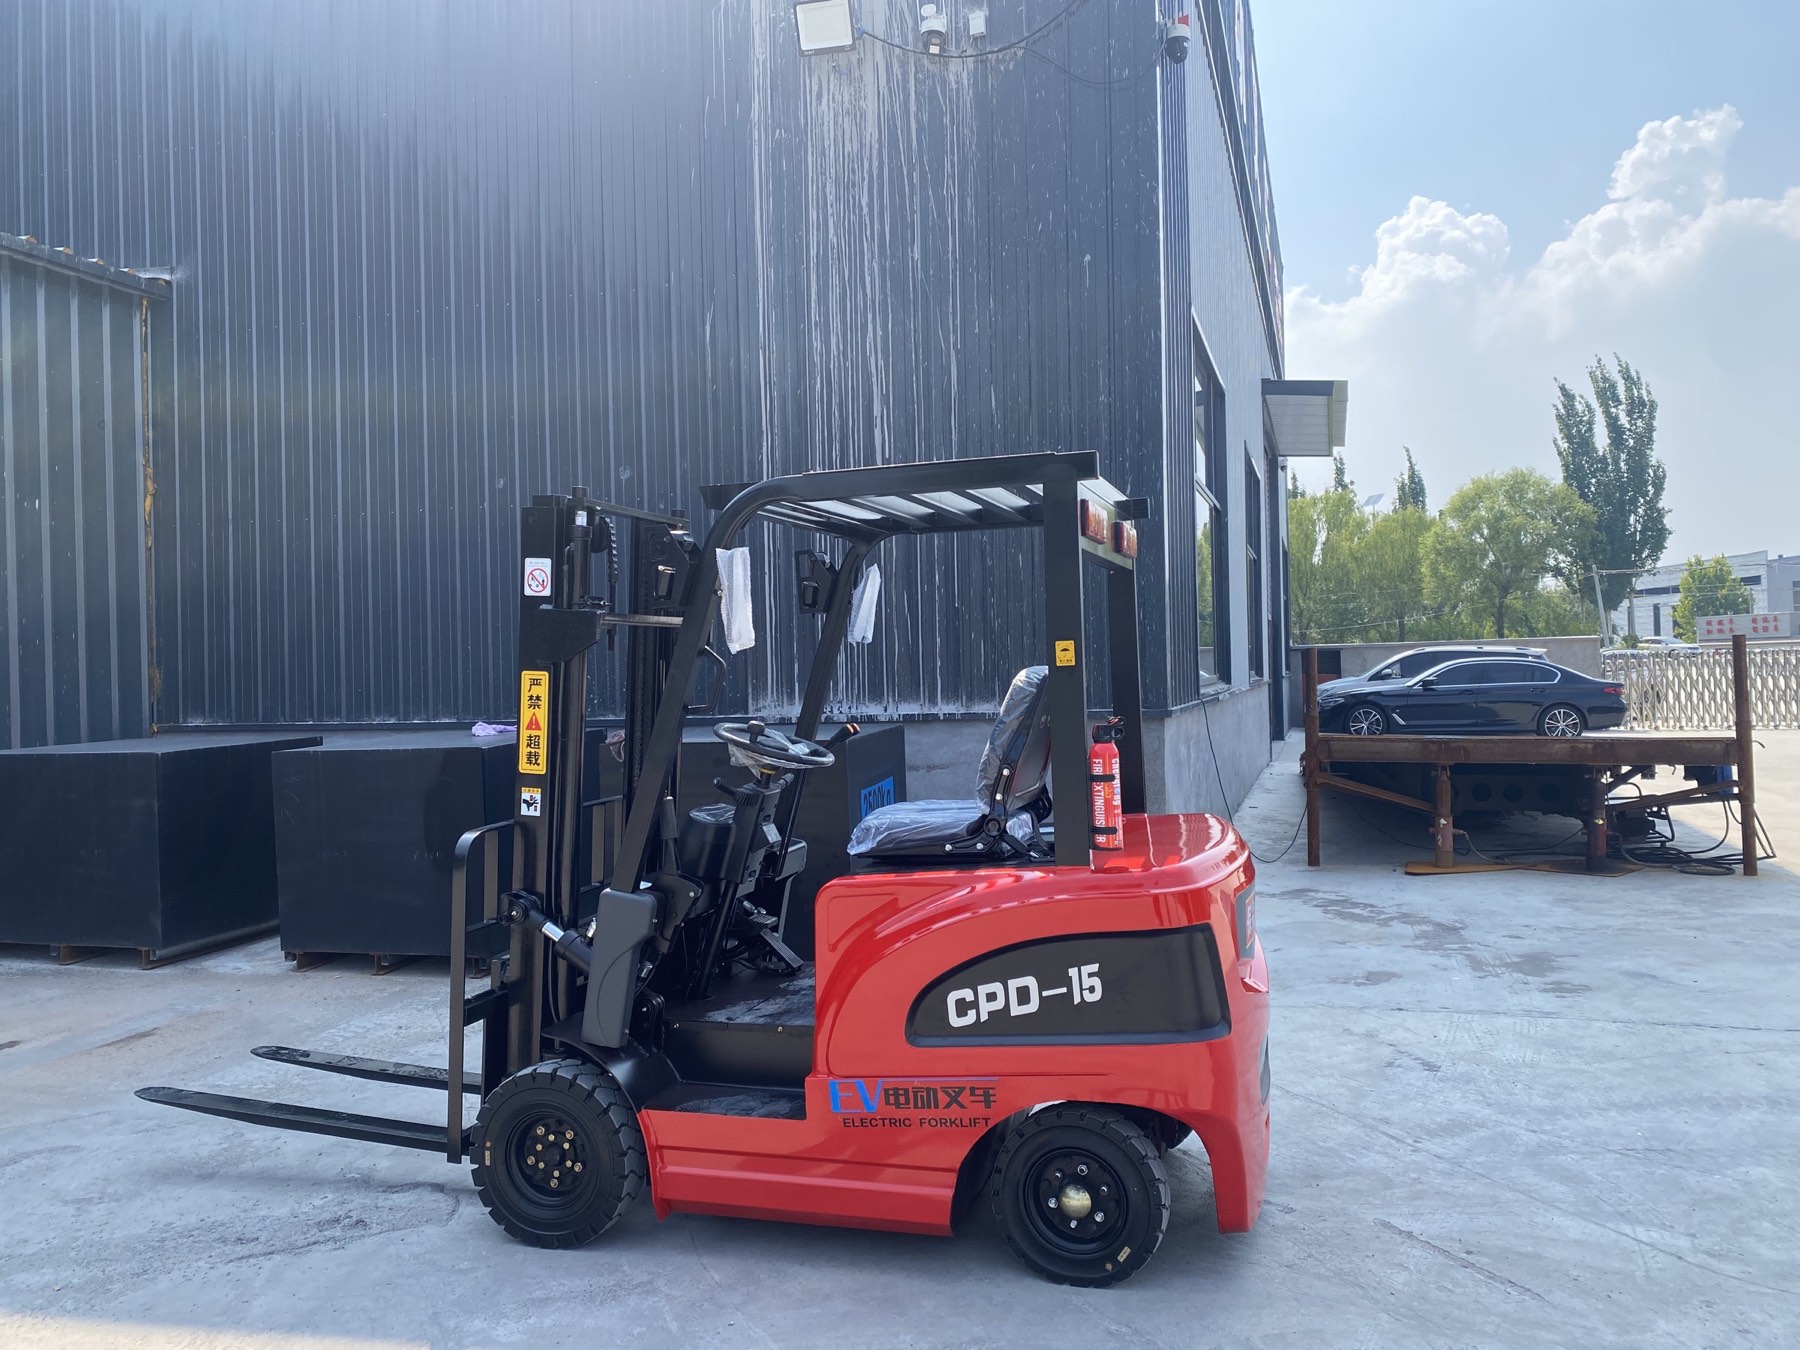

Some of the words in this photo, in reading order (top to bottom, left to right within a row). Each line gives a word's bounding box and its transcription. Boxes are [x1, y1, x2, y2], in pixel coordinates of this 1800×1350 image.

[527, 678, 542, 710] 严禁
[525, 734, 541, 766] 超载
[1092, 759, 1104, 776] FIR
[946, 963, 1103, 1028] CPD-15
[883, 1086, 998, 1110] 电动叉车
[843, 1117, 912, 1128] ELECTRIC
[919, 1117, 991, 1128] FORKLIFT
